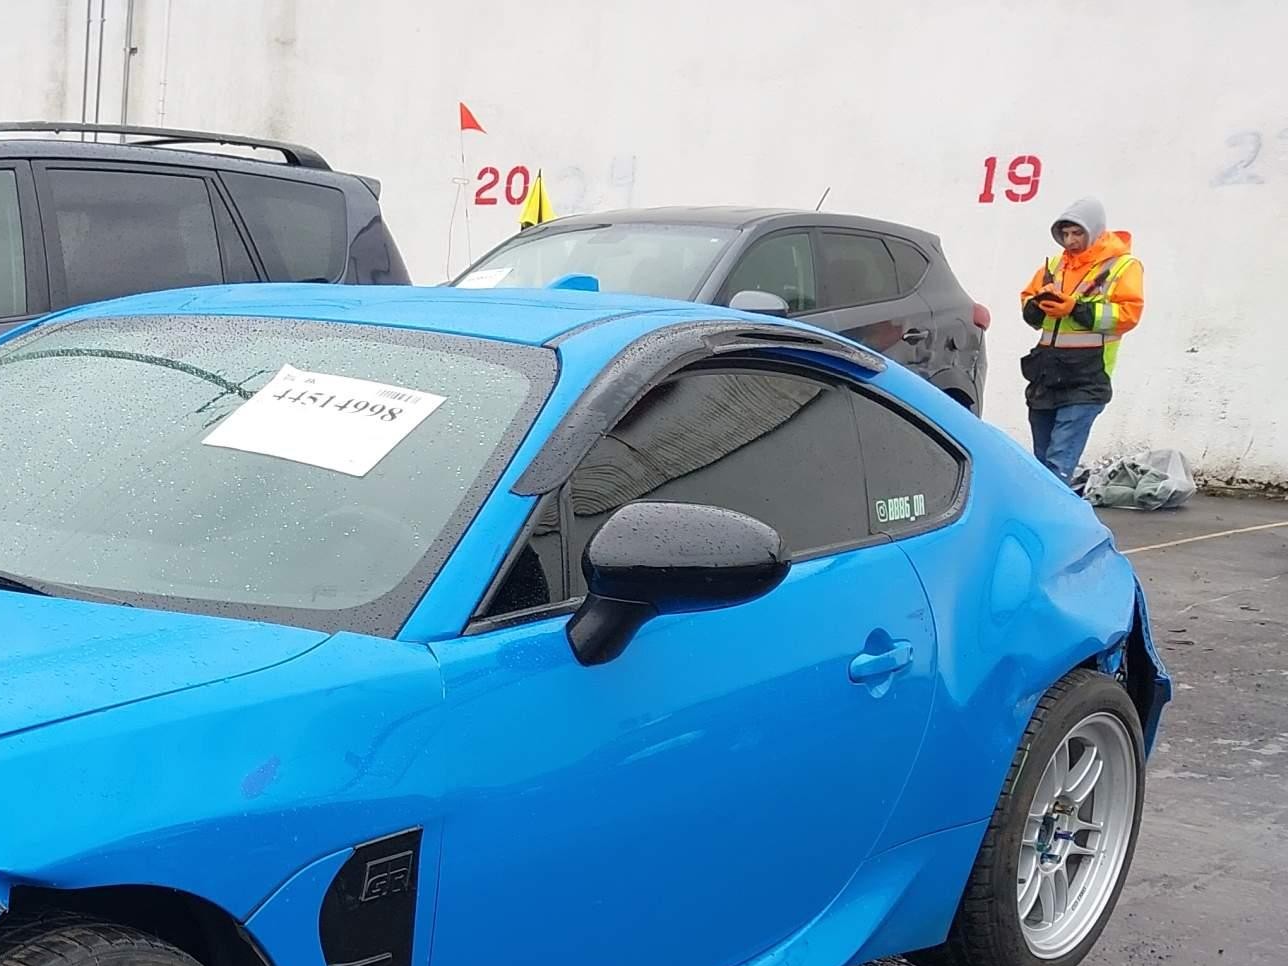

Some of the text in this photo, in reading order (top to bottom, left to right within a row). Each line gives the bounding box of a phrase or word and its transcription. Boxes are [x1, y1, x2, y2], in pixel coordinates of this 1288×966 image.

[474, 166, 530, 205] 20
[978, 155, 1041, 203] 19
[272, 388, 404, 422] 44514998
